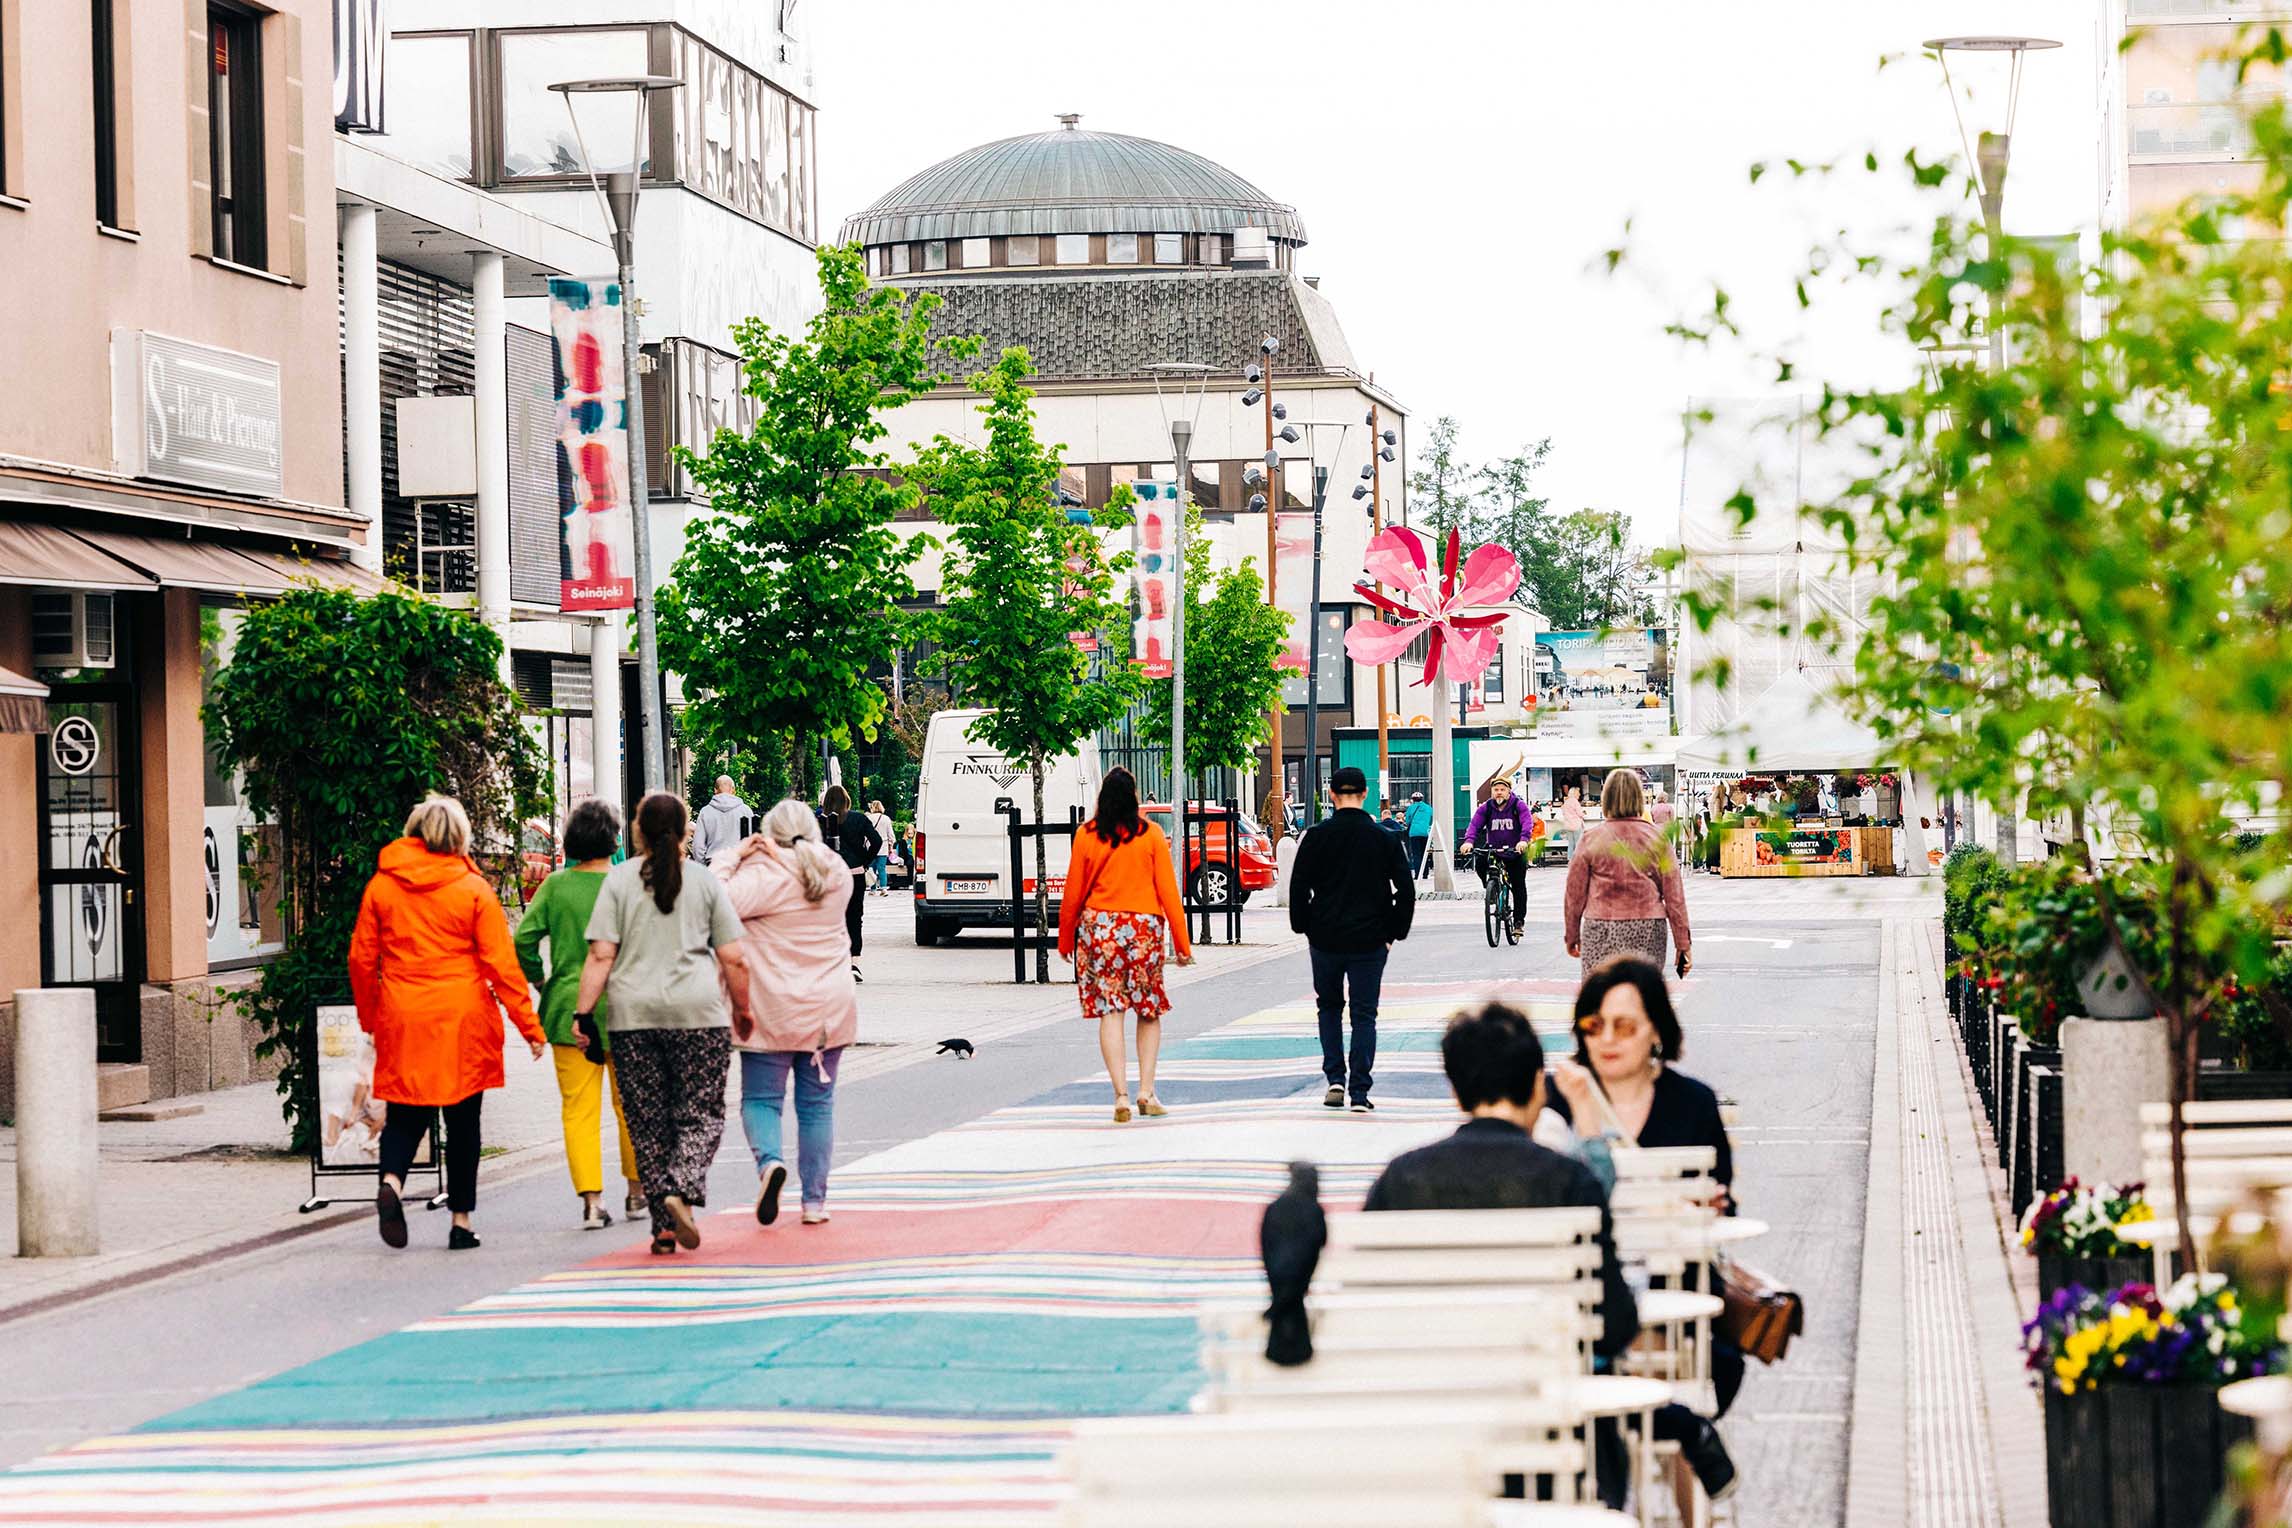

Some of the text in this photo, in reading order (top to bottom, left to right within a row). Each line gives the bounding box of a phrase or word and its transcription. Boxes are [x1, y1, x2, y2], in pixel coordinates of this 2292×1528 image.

[148, 353, 277, 467] S-Hair & Piercing
[570, 585, 624, 600] Seinäjoki
[61, 723, 89, 767] S
[1689, 771, 1744, 779] UUTTA PERUNAA
[953, 882, 987, 890] CMB-870
